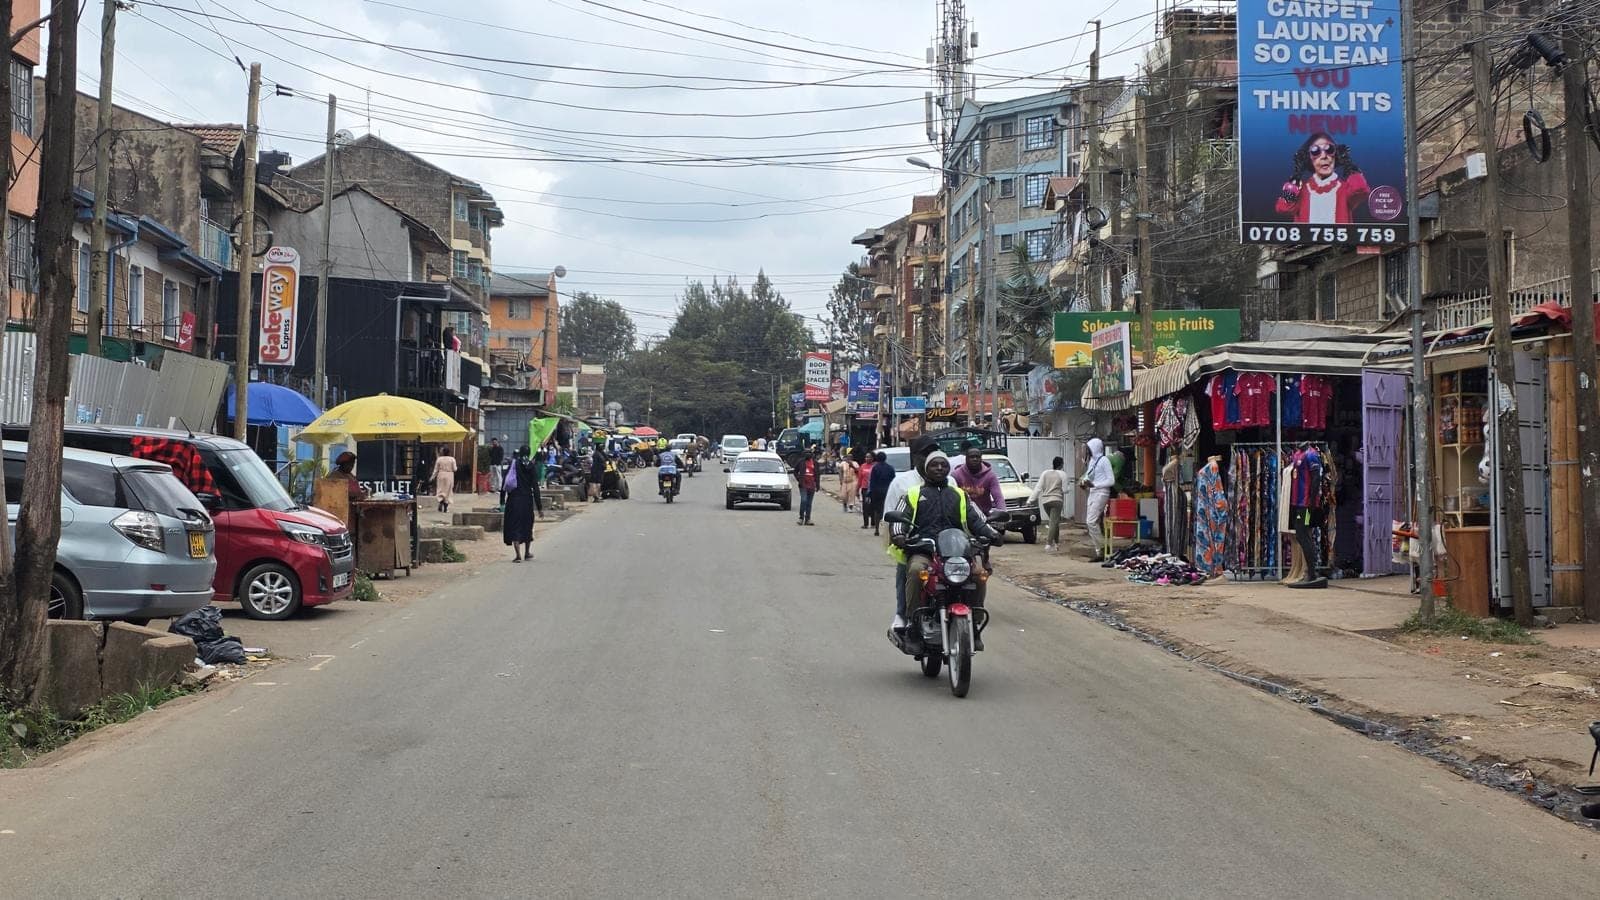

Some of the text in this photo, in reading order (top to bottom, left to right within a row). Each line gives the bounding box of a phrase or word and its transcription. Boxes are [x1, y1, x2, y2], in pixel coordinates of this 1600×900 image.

[1267, 0, 1373, 18] CARPET
[1257, 20, 1384, 42] LAUNDRY
[1254, 44, 1388, 65] SO CLEAN
[1293, 67, 1350, 88] YOU
[1253, 90, 1391, 112] THINK ITS
[1288, 114, 1357, 135] NEW!
[1249, 227, 1396, 242] 0708 755 759
[261, 270, 289, 360] Gateway
[1082, 319, 1111, 333] Soko
[1179, 317, 1215, 332] Fruits
[281, 319, 290, 350] Express
[391, 480, 412, 493] LET
